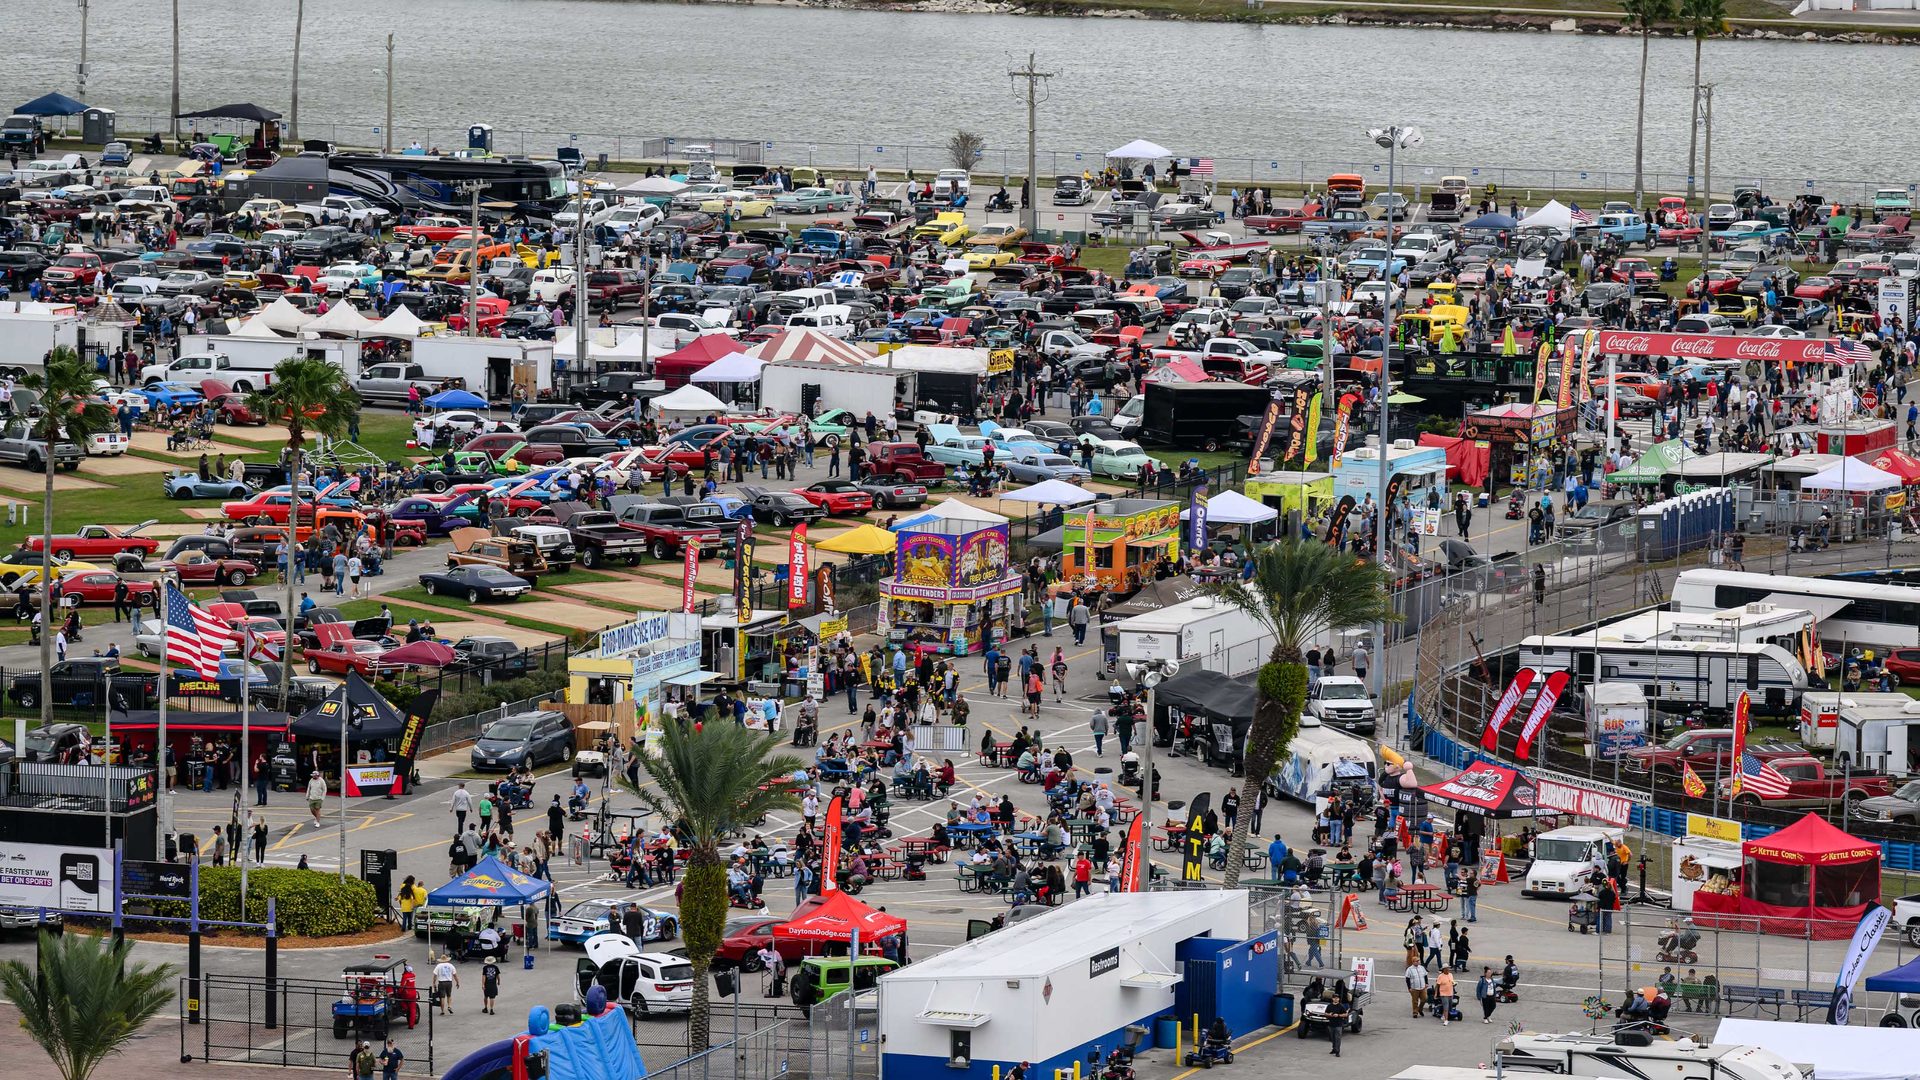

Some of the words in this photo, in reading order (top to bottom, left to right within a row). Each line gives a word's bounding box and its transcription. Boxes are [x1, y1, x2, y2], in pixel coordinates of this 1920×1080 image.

[1606, 335, 1650, 352] Coca-Cola
[1671, 337, 1717, 355] Coca-Cola
[1737, 340, 1782, 357] Coca-Cola
[909, 536, 927, 544] CHICKEN
[928, 536, 946, 547] TENDERS
[970, 574, 981, 583] FRIED
[893, 586, 919, 596] CHICKEN
[919, 588, 945, 598] TENDERS
[1125, 601, 1163, 609] AudioArt
[650, 615, 669, 641] CREAM
[635, 665, 651, 676] SAUSAGE
[179, 681, 220, 691] MECUM
[324, 703, 337, 715] M
[1490, 680, 1521, 734] BURNOUT
[1521, 684, 1556, 744] BURNOUT
[400, 715, 421, 757] MECUM
[360, 771, 390, 779] MECUM
[1539, 779, 1580, 813] BURNOUT
[1581, 790, 1631, 825] NATIONALS
[1511, 809, 1532, 817] BURNOUT
[1185, 815, 1203, 881] ATM
[1758, 847, 1779, 857] KETTLE
[1781, 850, 1797, 859] CORN
[1829, 851, 1849, 861] KETTLE
[1851, 848, 1866, 858] CORN
[5, 867, 33, 876] FASTEST
[34, 869, 50, 877] WAY
[1121, 840, 1135, 893] AYTONA
[25, 878, 52, 886] SPORTS
[171, 876, 184, 884] Rock
[466, 878, 502, 888] SUNOCO
[788, 927, 852, 938] DaytonaDodge.com
[1262, 941, 1277, 953] OMEN
[1845, 953, 1863, 989] Coker
[1860, 910, 1885, 952] Classic
[1091, 954, 1118, 974] Restrooms
[1223, 957, 1233, 970] MEN
